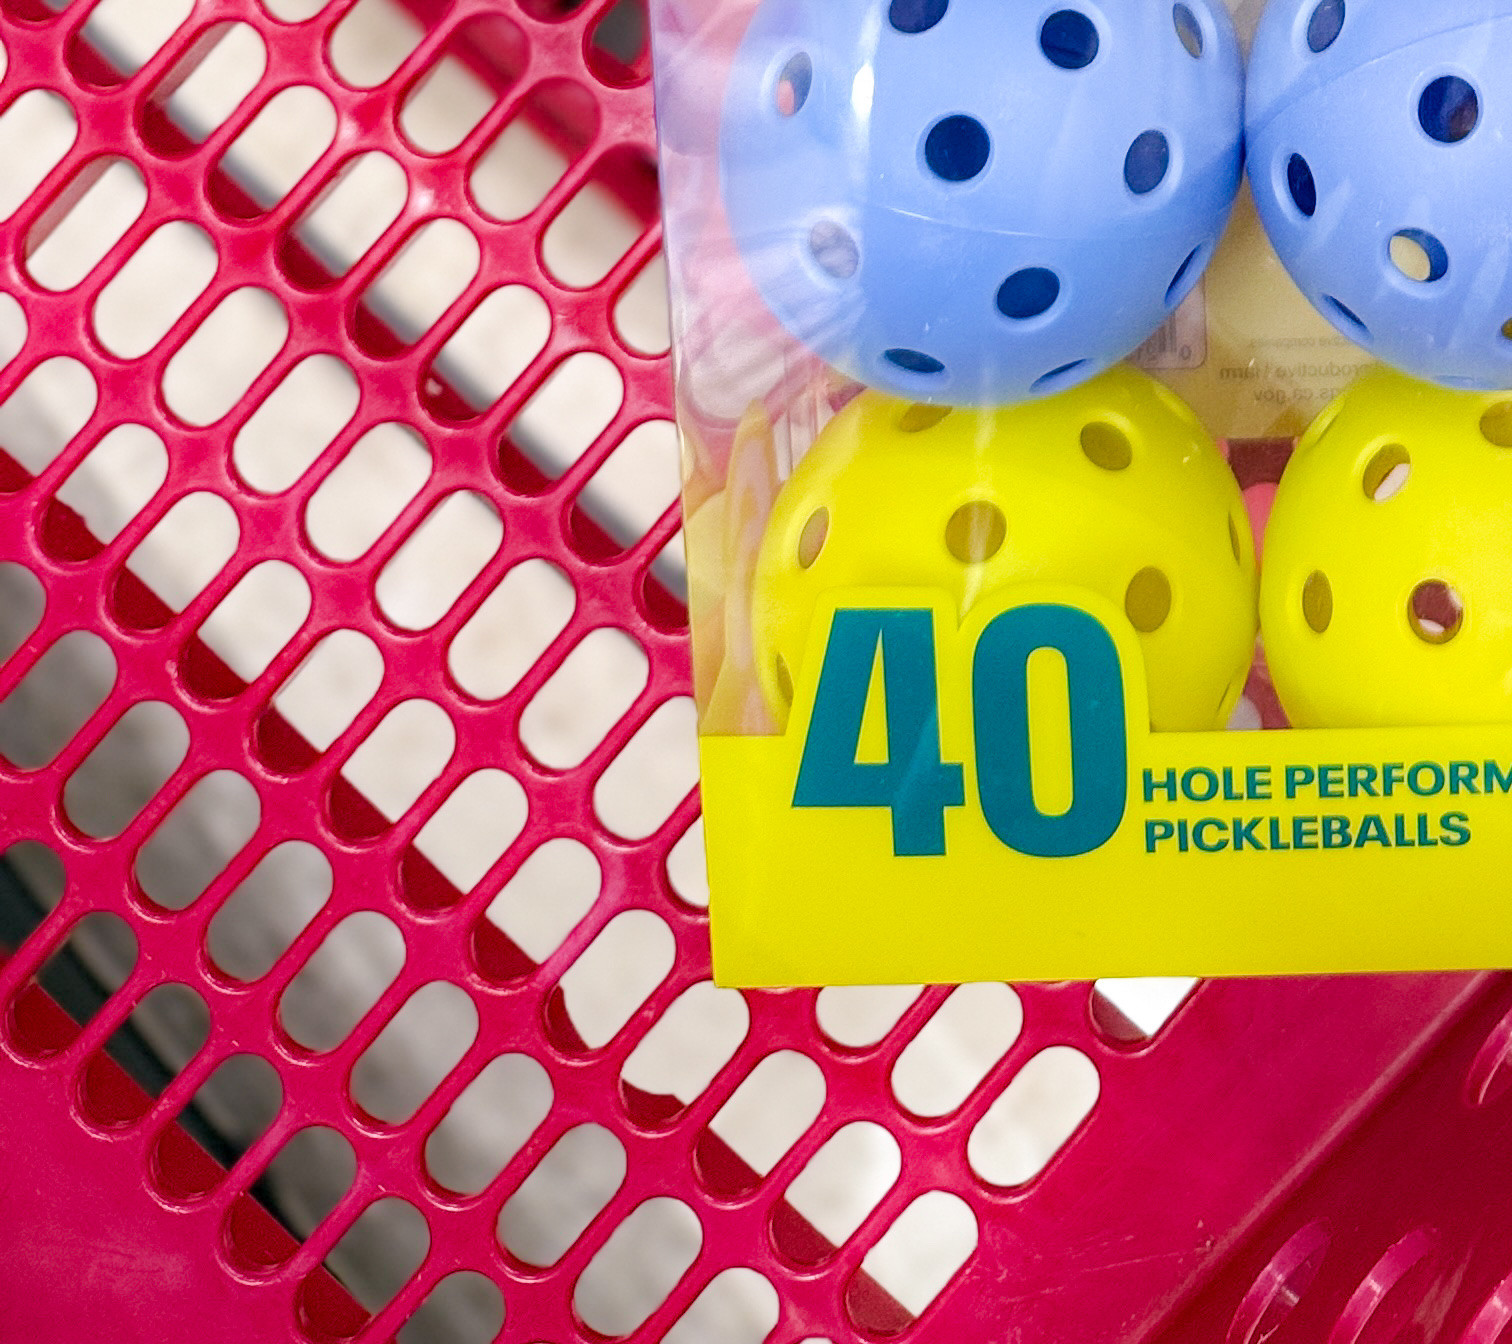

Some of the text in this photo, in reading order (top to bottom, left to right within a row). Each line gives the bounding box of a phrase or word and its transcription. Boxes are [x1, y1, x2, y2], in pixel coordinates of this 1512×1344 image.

[791, 603, 1128, 860] 40
[1142, 767, 1272, 803] HOLE
[1144, 811, 1471, 854] PICKLEBALLS
